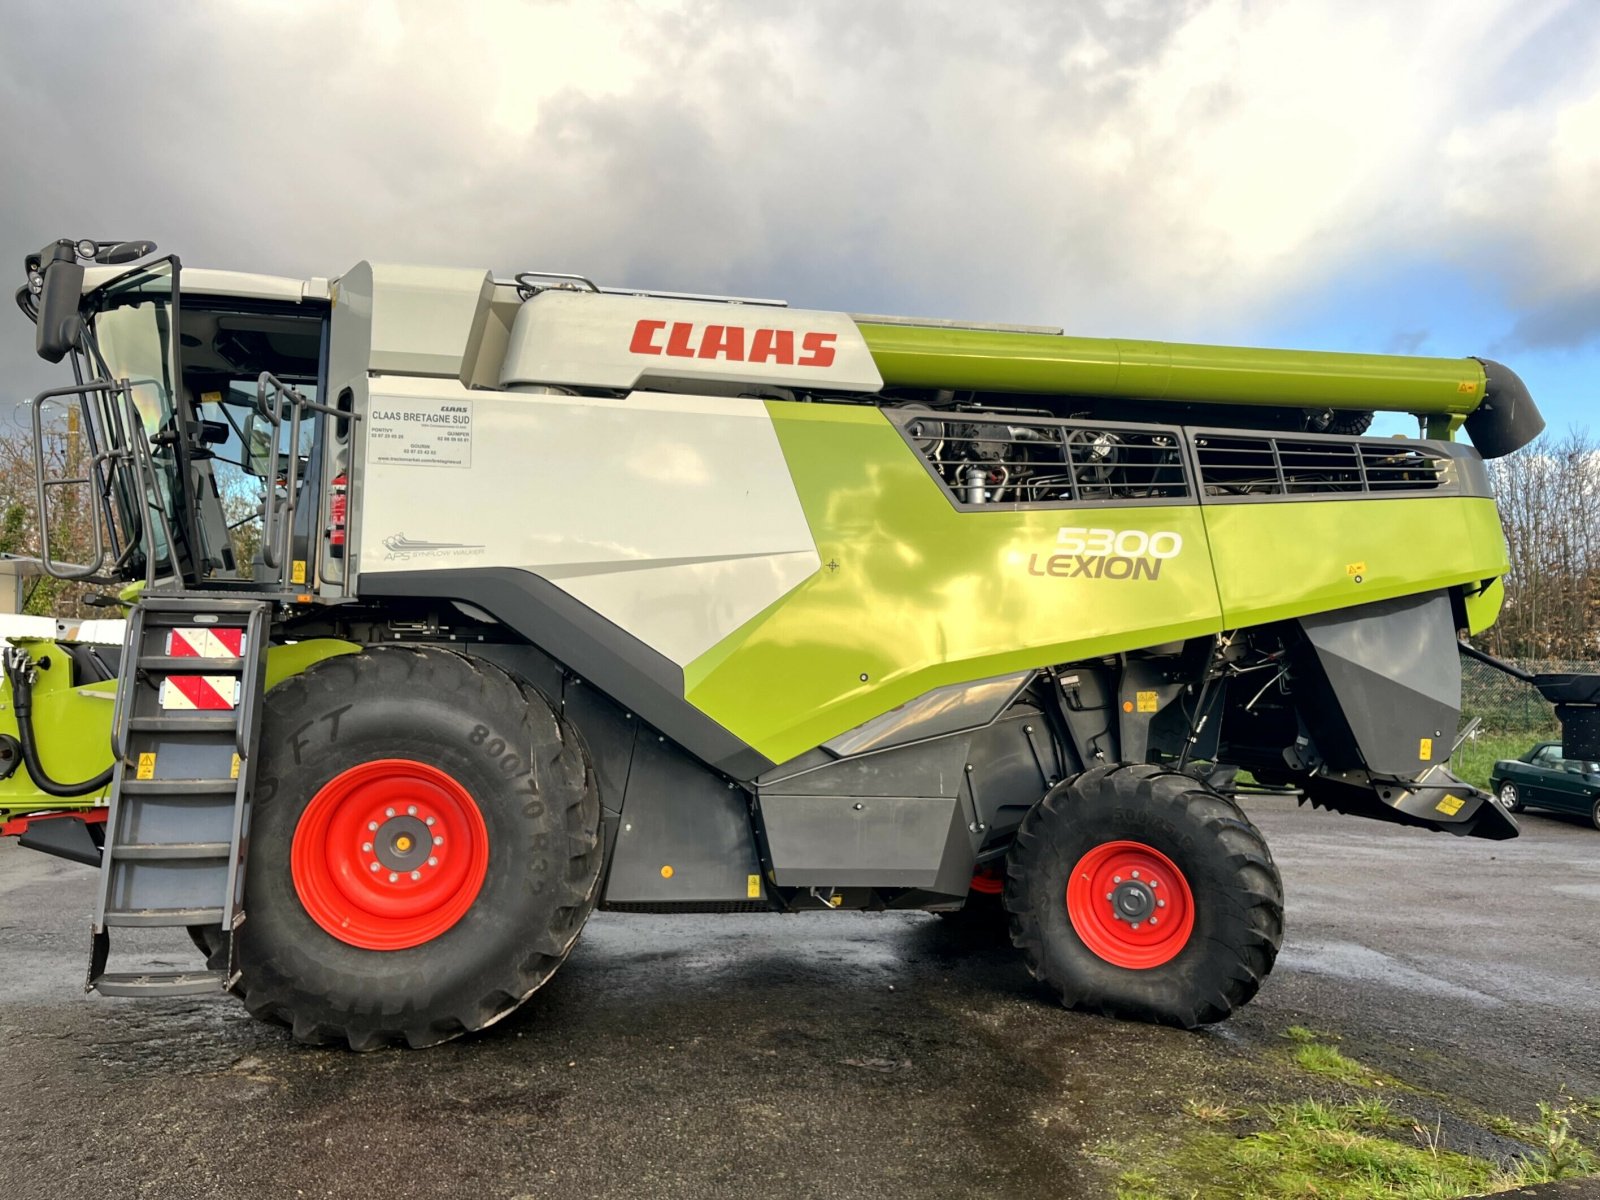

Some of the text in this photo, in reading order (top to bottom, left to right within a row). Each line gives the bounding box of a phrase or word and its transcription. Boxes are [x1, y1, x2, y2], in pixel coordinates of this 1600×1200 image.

[629, 319, 837, 367] CLAAS
[372, 411, 470, 424] CLAAS BRETAGNE SUD
[384, 552, 411, 561] APS
[1053, 526, 1183, 559] 5300
[1028, 553, 1163, 581] LEXION
[469, 724, 545, 819] 800/70
